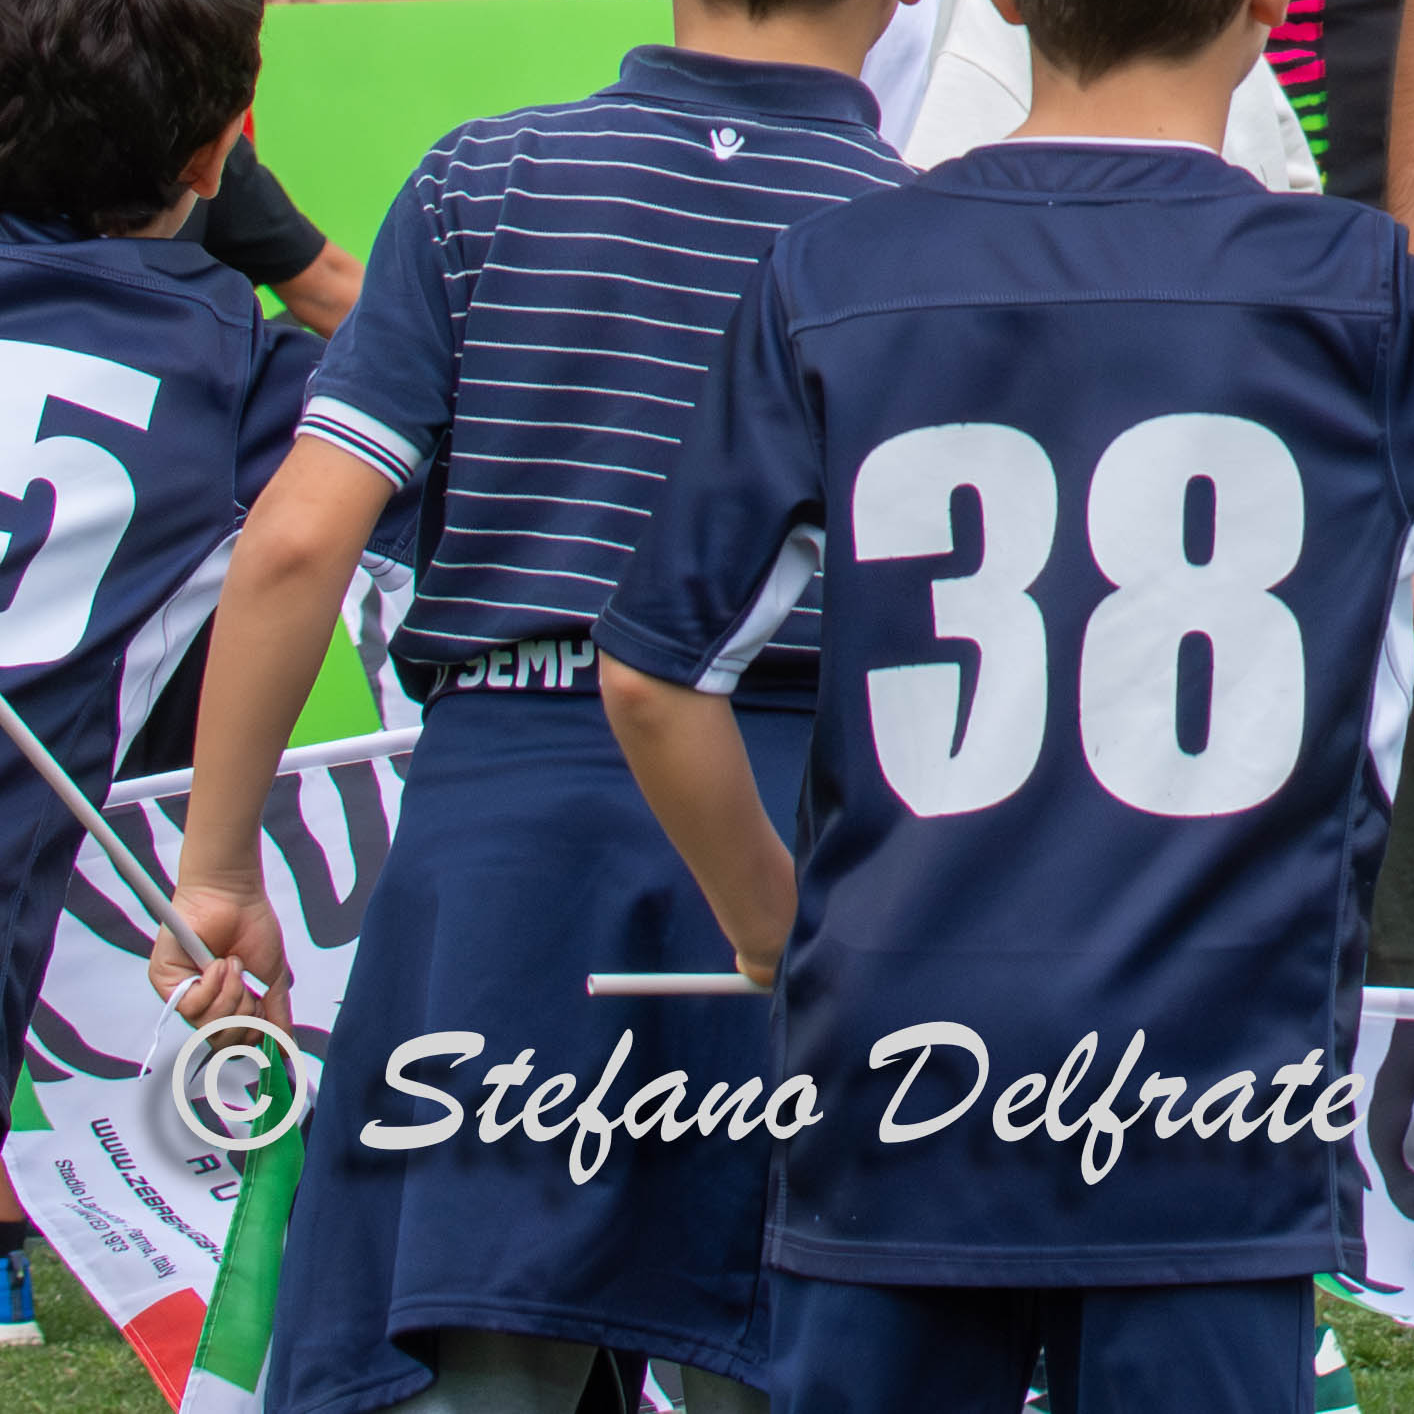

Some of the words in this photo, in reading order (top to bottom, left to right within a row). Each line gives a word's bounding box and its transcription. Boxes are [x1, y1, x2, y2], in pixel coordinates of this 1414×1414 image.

[457, 640, 602, 688] SEMP
[851, 411, 1306, 818] 38
[55, 1158, 87, 1197] Stadio
[151, 1254, 178, 1280] Italy
